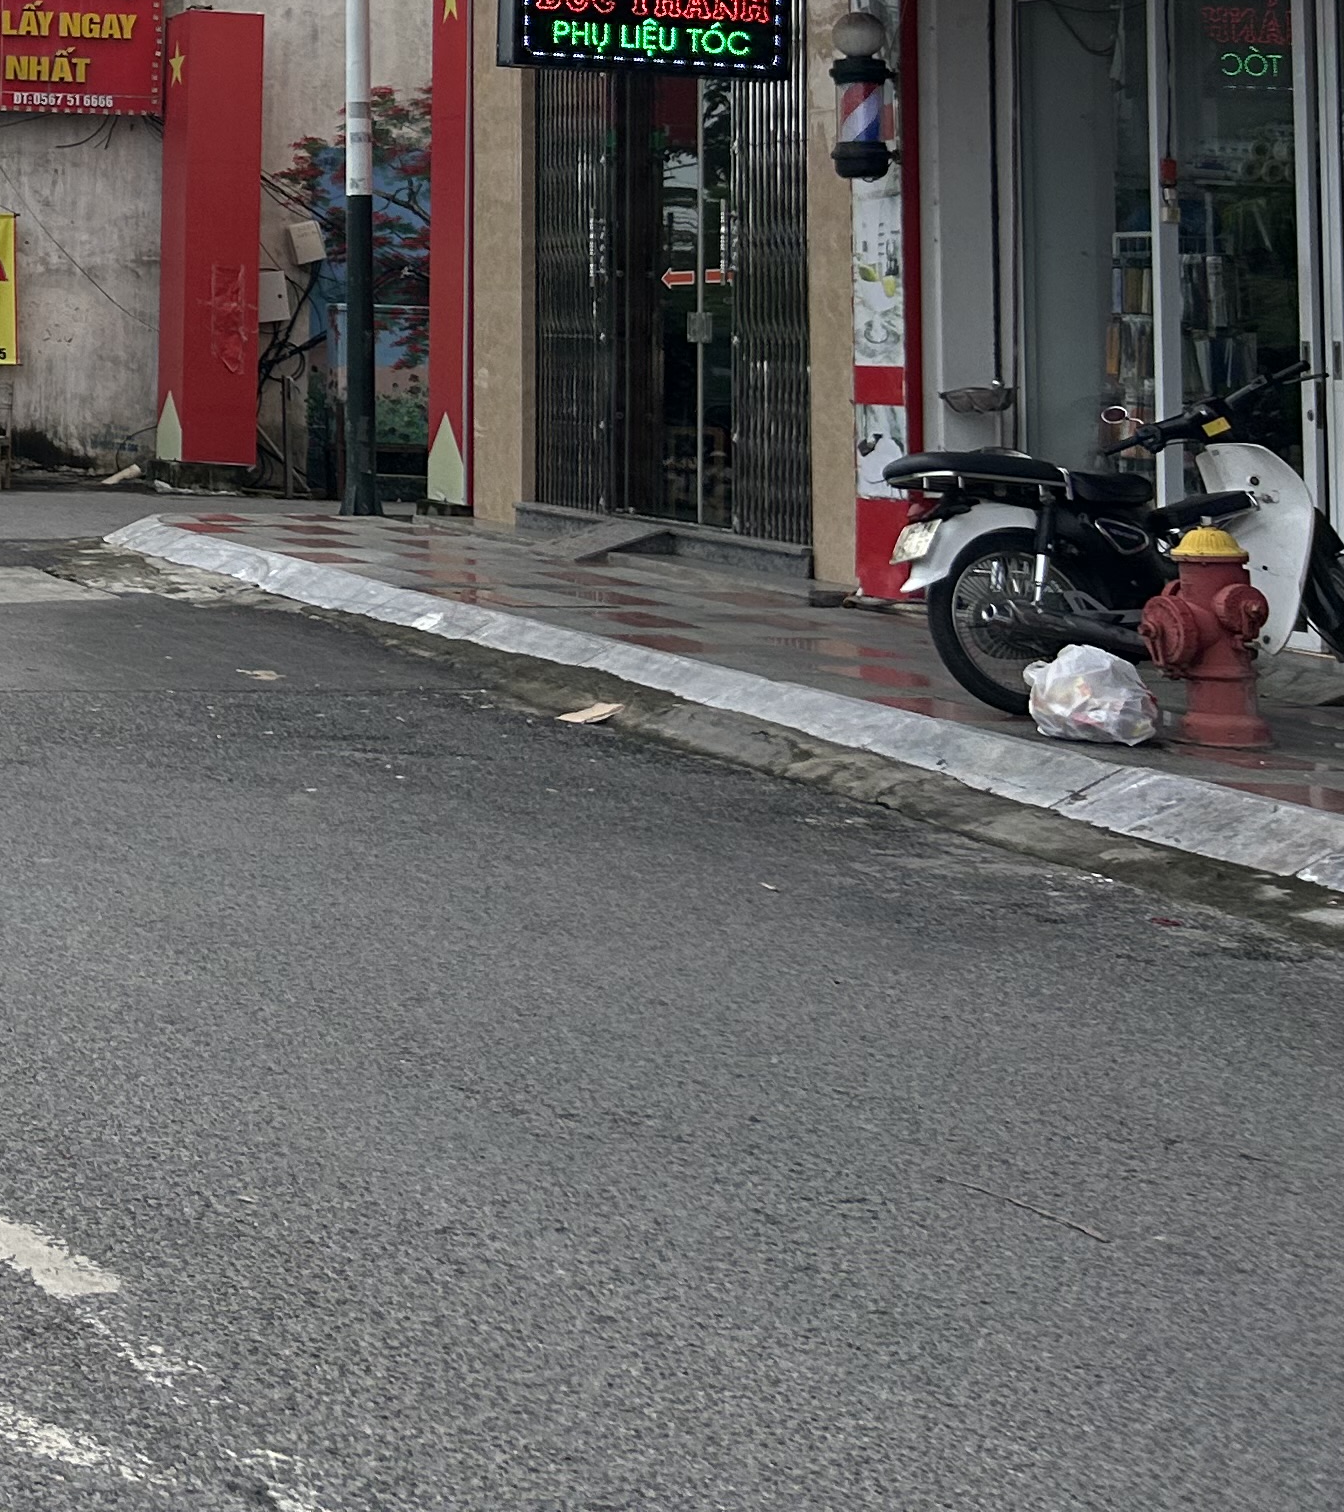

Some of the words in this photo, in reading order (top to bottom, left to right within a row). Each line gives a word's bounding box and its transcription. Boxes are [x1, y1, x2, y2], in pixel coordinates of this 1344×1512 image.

[3, 0, 55, 37] LẤY
[59, 13, 138, 40] NGAY
[552, 19, 611, 53] PHỤ
[620, 17, 677, 57] LIỆU
[686, 21, 751, 56] TÓC
[5, 46, 92, 84] NHẤT
[67, 94, 81, 107] 51
[83, 94, 114, 108] 6666
